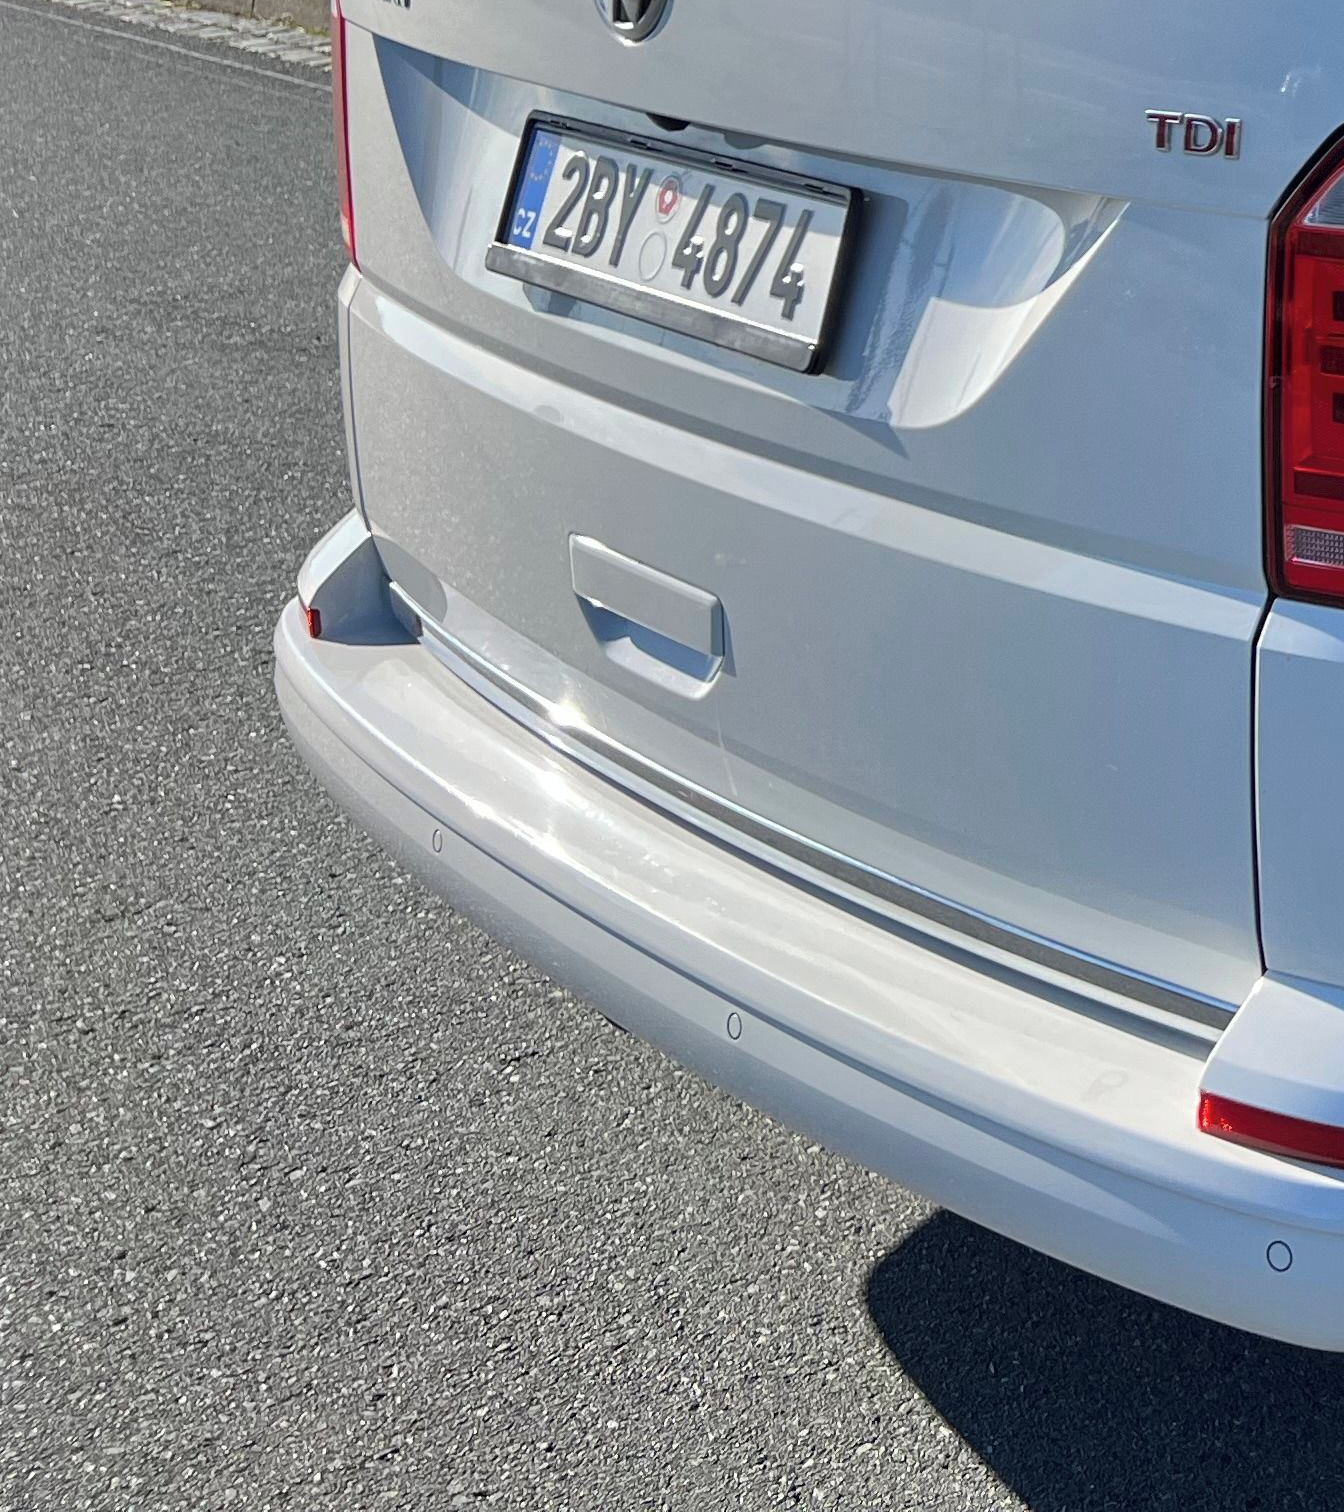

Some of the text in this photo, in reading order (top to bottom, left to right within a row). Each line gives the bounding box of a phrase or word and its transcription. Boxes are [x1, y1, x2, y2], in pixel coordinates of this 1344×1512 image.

[1145, 108, 1242, 160] TDI
[512, 207, 536, 240] CZ
[542, 150, 815, 322] 2BY 4874
